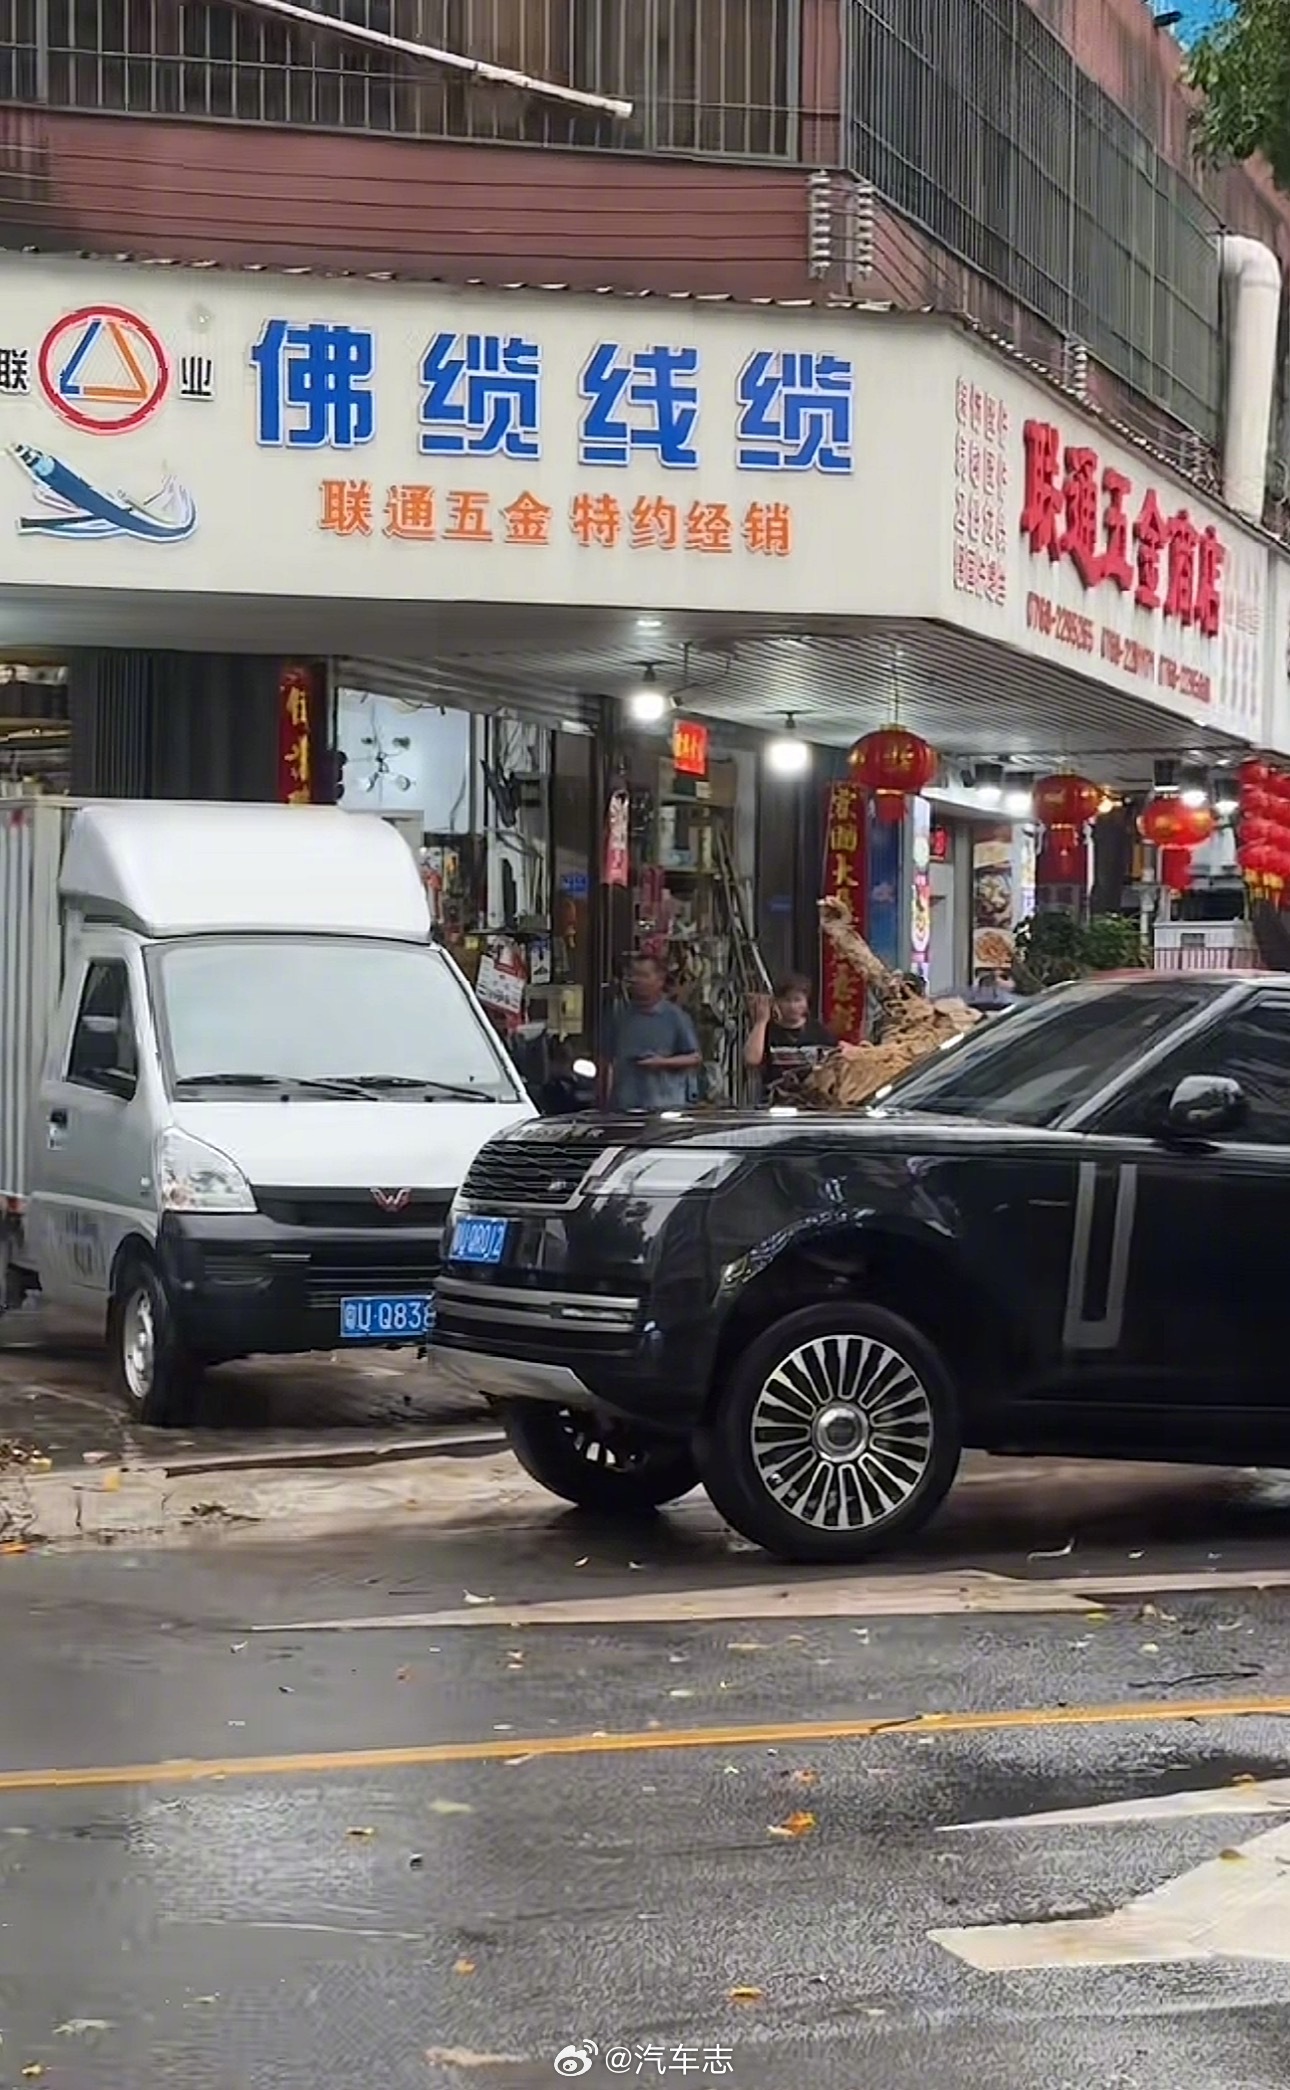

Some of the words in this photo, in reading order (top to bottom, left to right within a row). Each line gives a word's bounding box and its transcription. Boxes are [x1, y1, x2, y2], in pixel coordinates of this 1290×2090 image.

[180, 355, 213, 398] 业
[250, 319, 854, 473] 佛缆线缆
